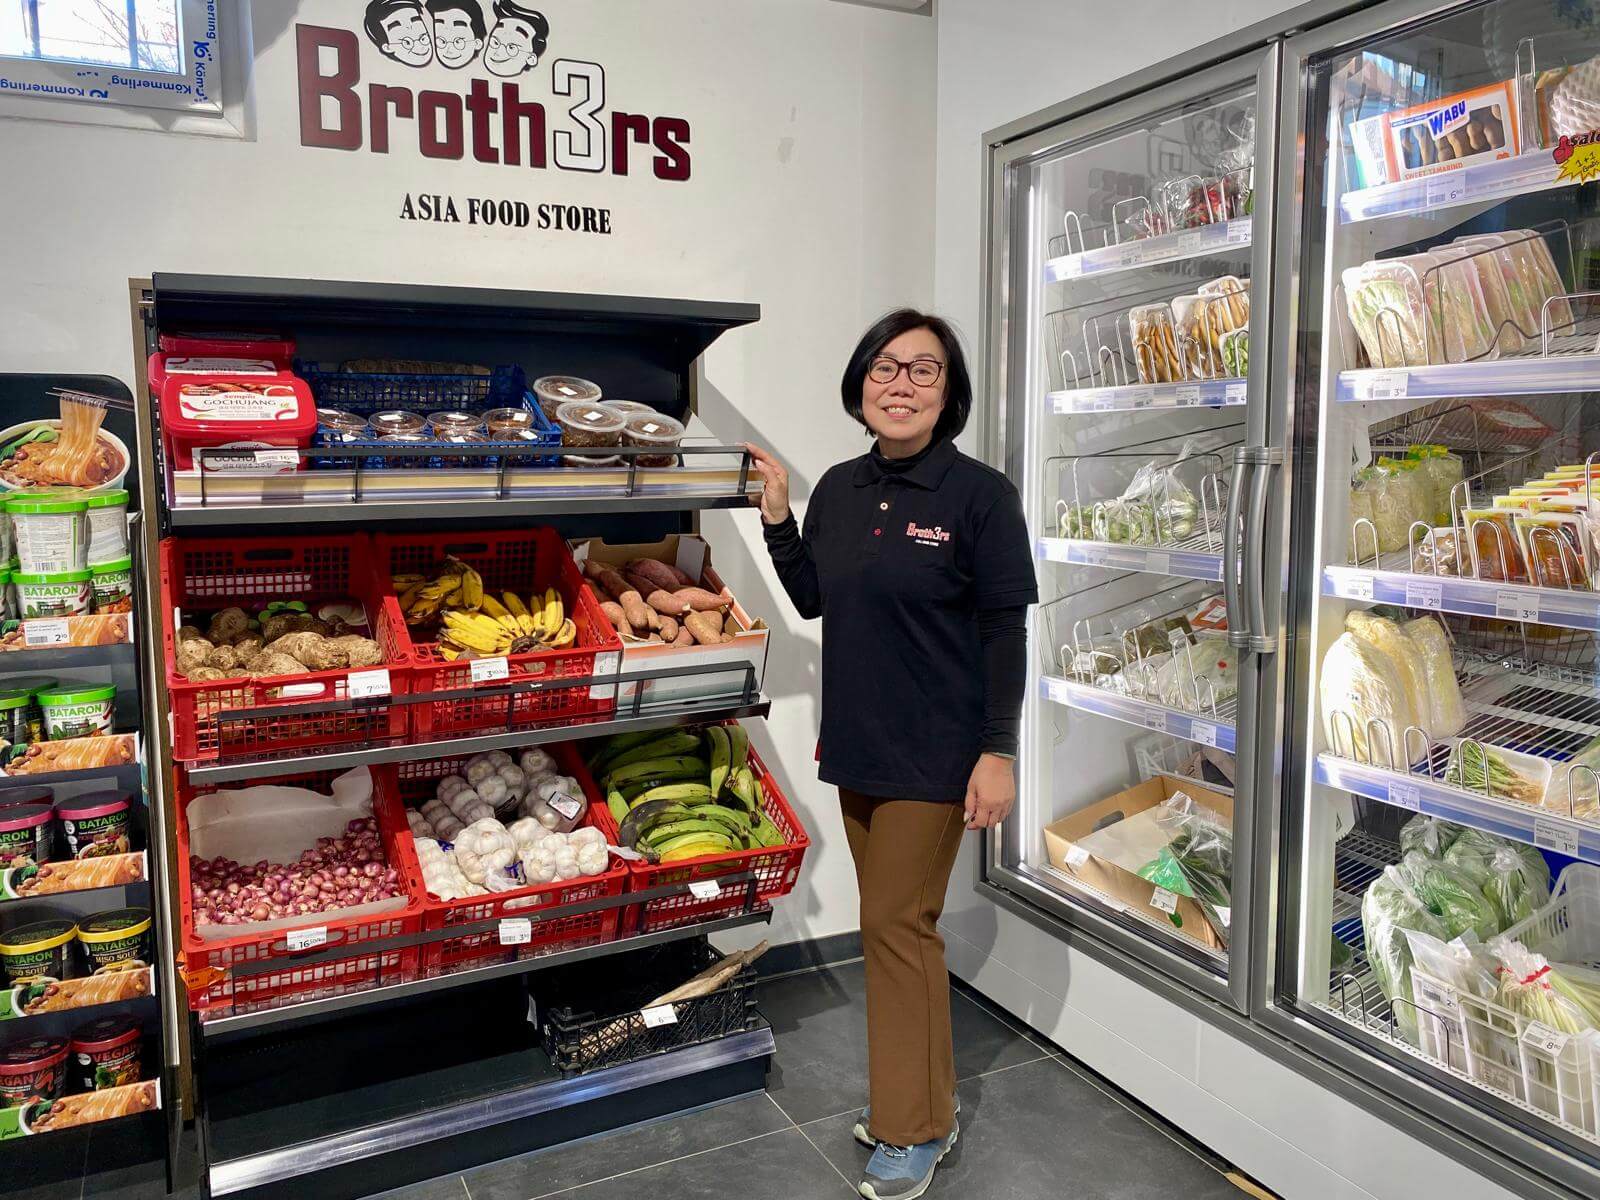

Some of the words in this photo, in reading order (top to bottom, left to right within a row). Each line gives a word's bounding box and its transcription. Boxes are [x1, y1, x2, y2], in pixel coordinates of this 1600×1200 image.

[111, 74, 192, 95] Kömmerling
[295, 23, 691, 182] Broth3rs
[1428, 100, 1466, 136] WABU
[1405, 170, 1426, 180] SWEET
[399, 193, 459, 223] ASIA
[467, 197, 530, 228] FOOD
[537, 203, 612, 235] STORE
[906, 521, 951, 542] Broth3rs
[24, 585, 79, 596] BATARON
[49, 704, 102, 718] BATARON
[79, 811, 129, 830] BATARON
[116, 949, 139, 961] SOUP
